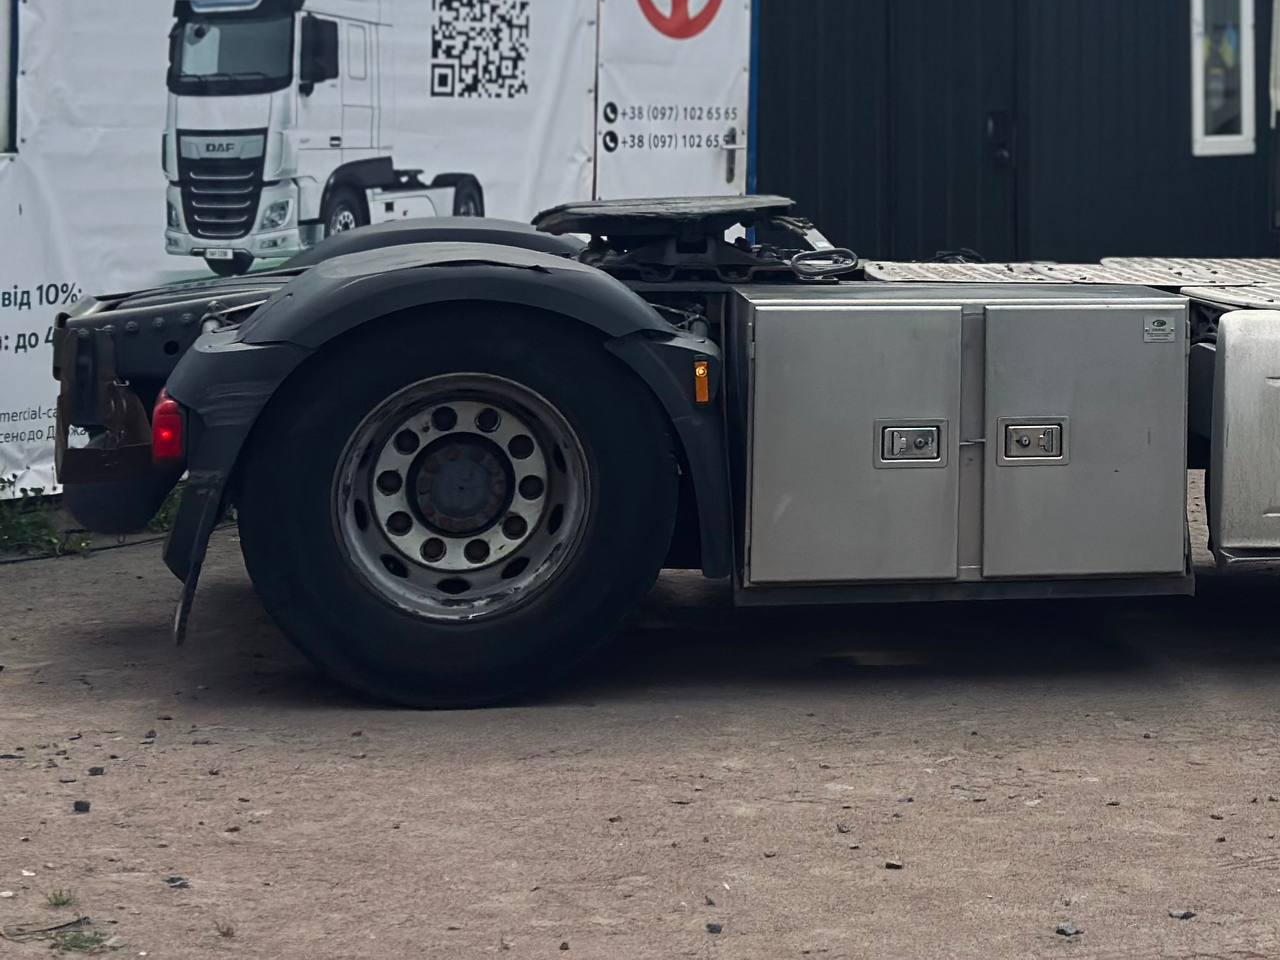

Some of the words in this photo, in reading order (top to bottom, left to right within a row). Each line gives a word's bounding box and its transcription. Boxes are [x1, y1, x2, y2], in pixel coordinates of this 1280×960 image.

[620, 106, 644, 120] +38
[647, 104, 679, 121] (097)
[683, 106, 704, 120] 102
[706, 106, 721, 120] 65
[724, 106, 738, 120] 65
[206, 143, 236, 152] DAF
[621, 134, 645, 149] +38
[648, 133, 678, 150] (097)
[682, 134, 703, 148] 102
[705, 134, 720, 148] 65
[2, 284, 31, 311] від
[15, 331, 39, 354] до
